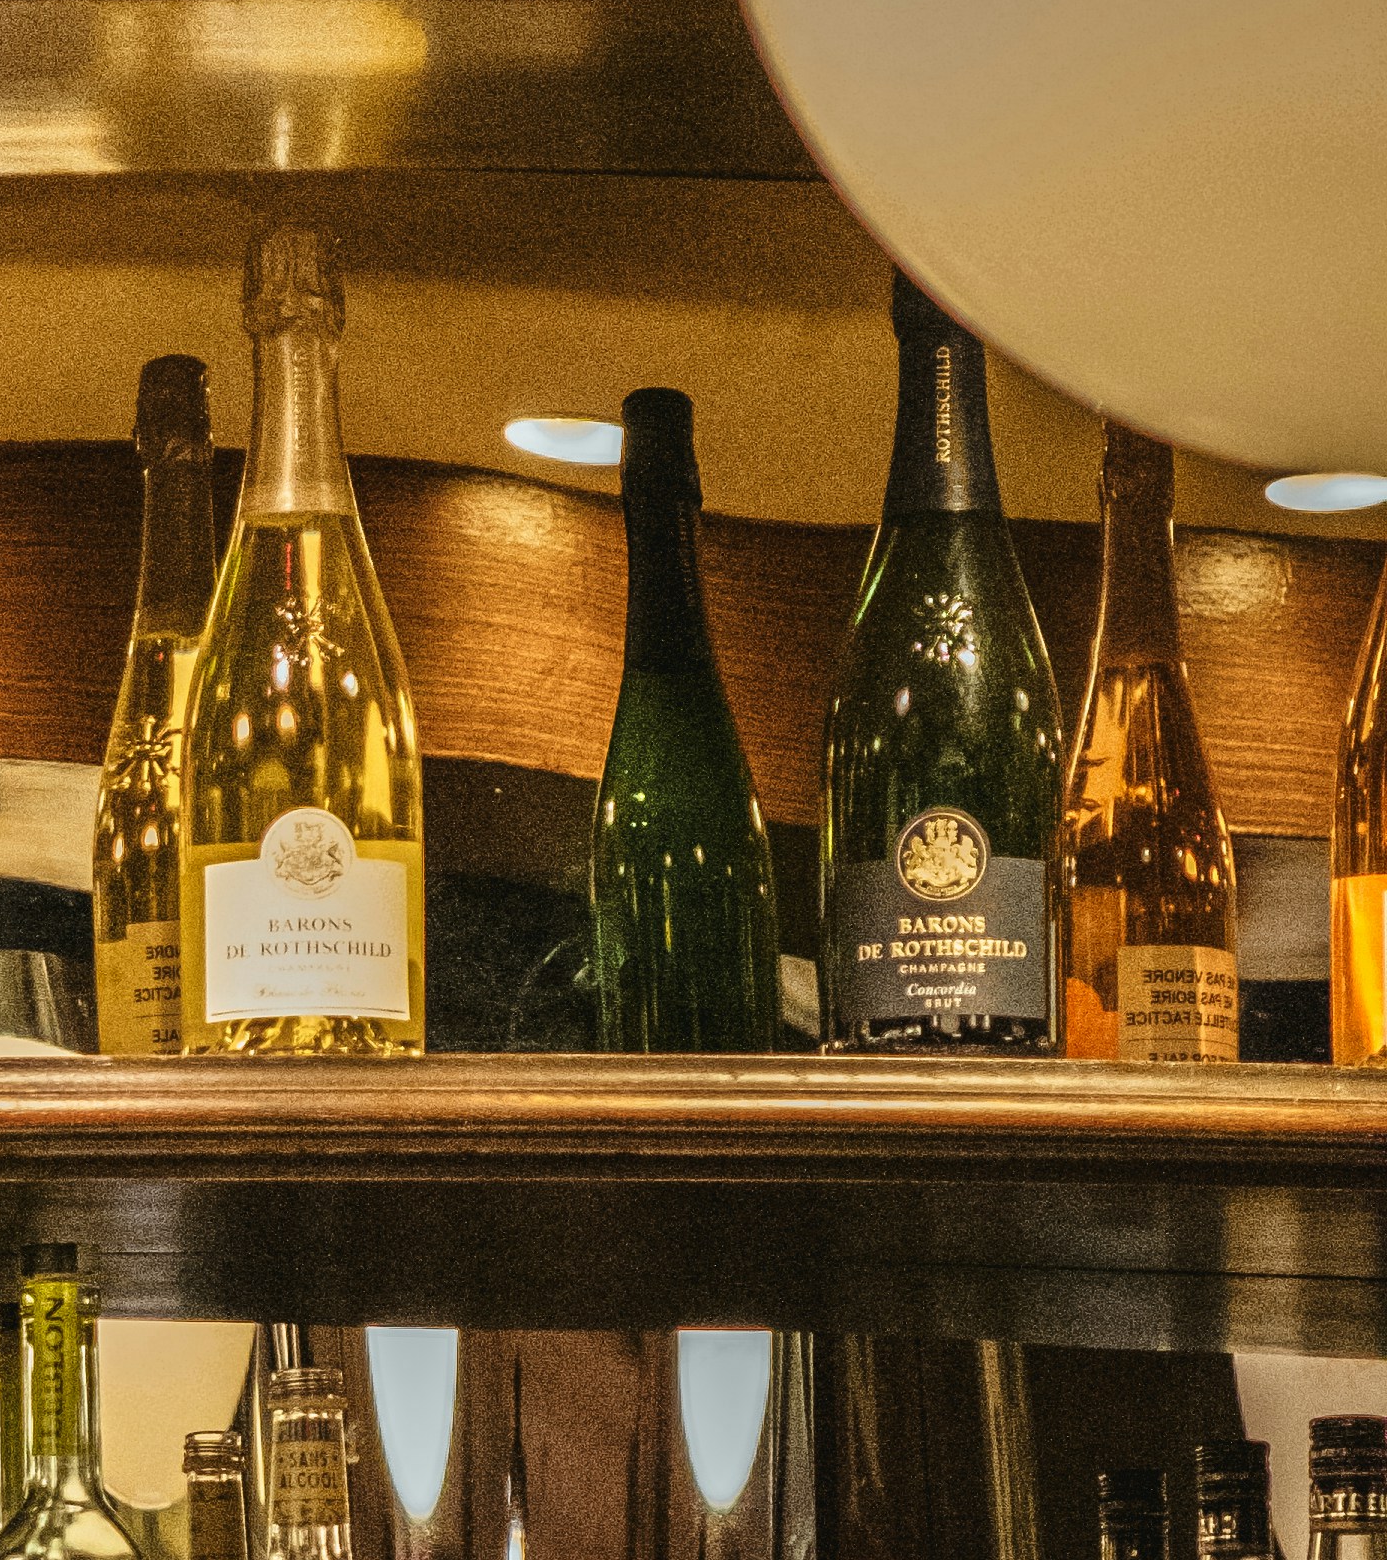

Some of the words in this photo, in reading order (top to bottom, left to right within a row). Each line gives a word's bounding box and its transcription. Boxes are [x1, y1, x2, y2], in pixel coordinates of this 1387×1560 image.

[269, 917, 353, 933] BARONS
[898, 916, 986, 934] BARONS
[227, 944, 250, 960] DE
[260, 940, 391, 958] ROTHSCHILD
[858, 944, 883, 960] DE
[890, 939, 1028, 958] ROTHSCHILD
[899, 963, 986, 974] CHAMPAGNE
[907, 982, 977, 996] Concordia
[925, 997, 962, 1008] BRUT
[280, 1471, 339, 1489] ALCOOL
